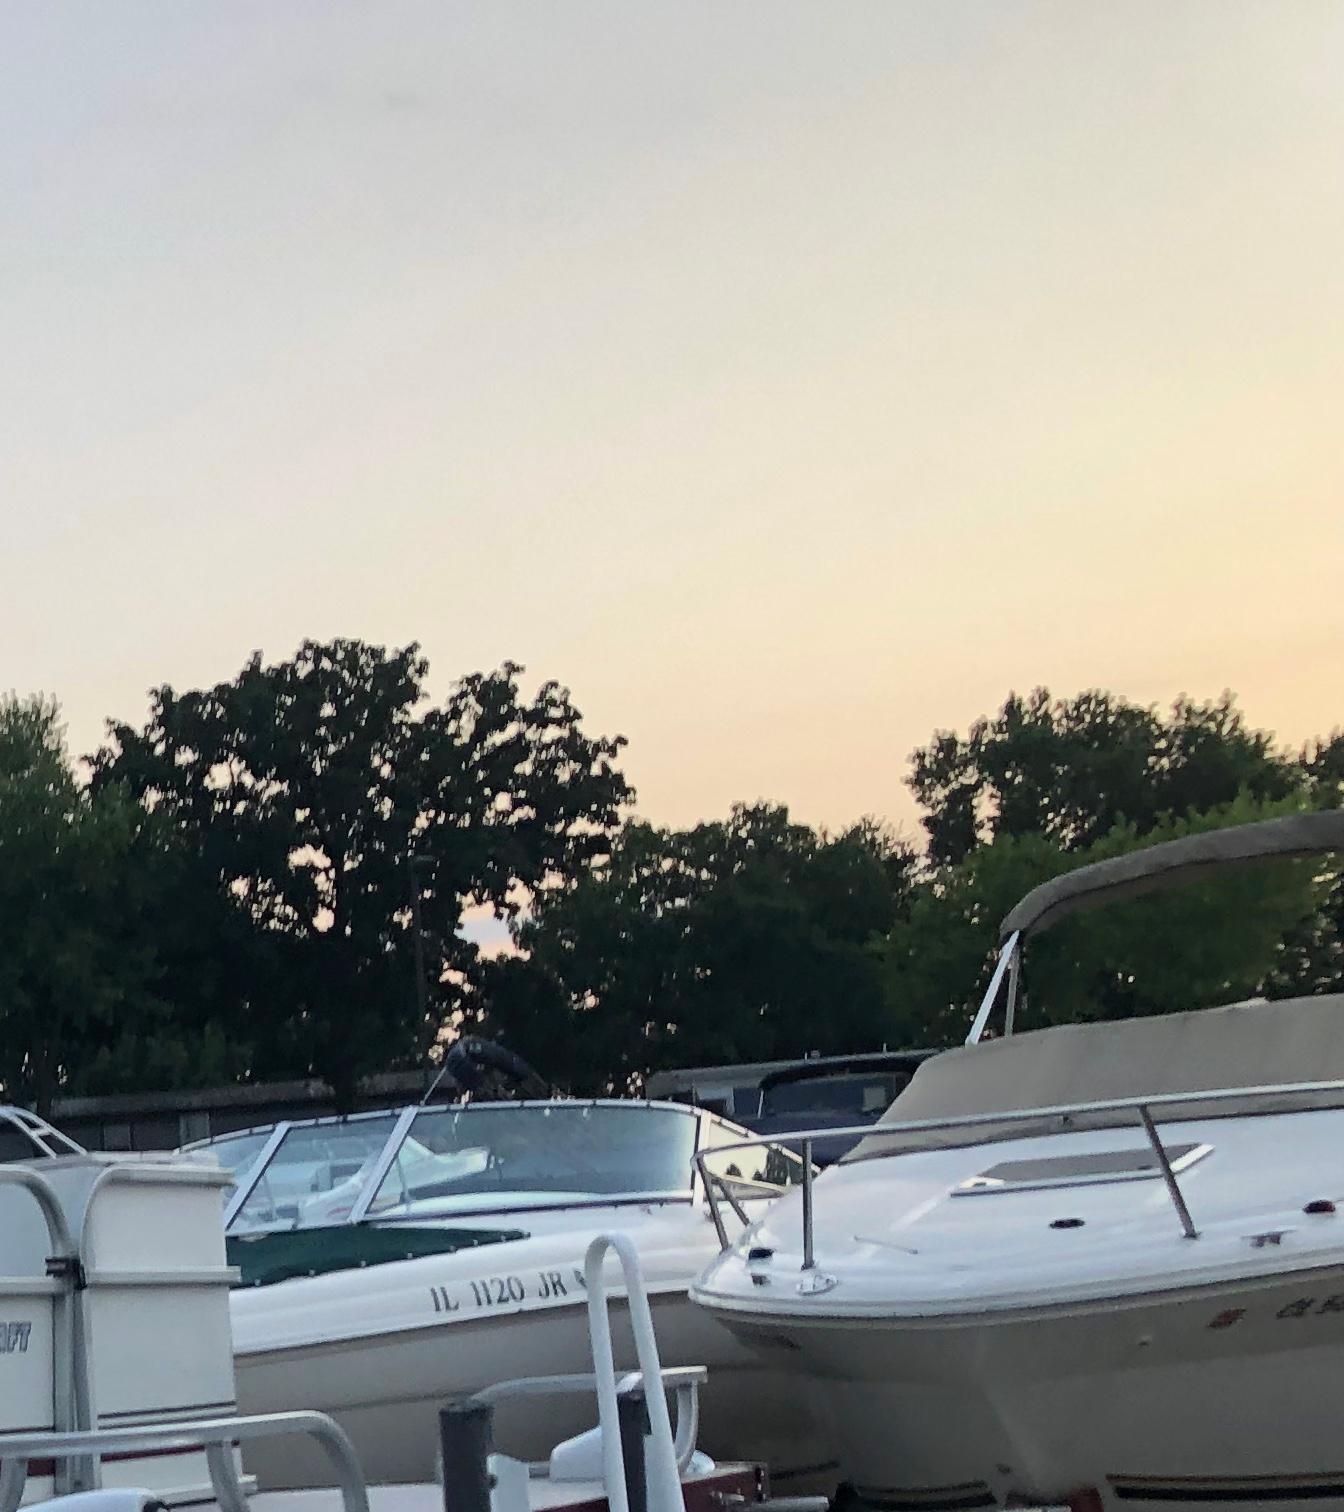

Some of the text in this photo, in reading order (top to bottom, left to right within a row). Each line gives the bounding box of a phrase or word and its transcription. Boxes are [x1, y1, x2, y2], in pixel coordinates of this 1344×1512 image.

[430, 1271, 568, 1312] IL 1120 JR
